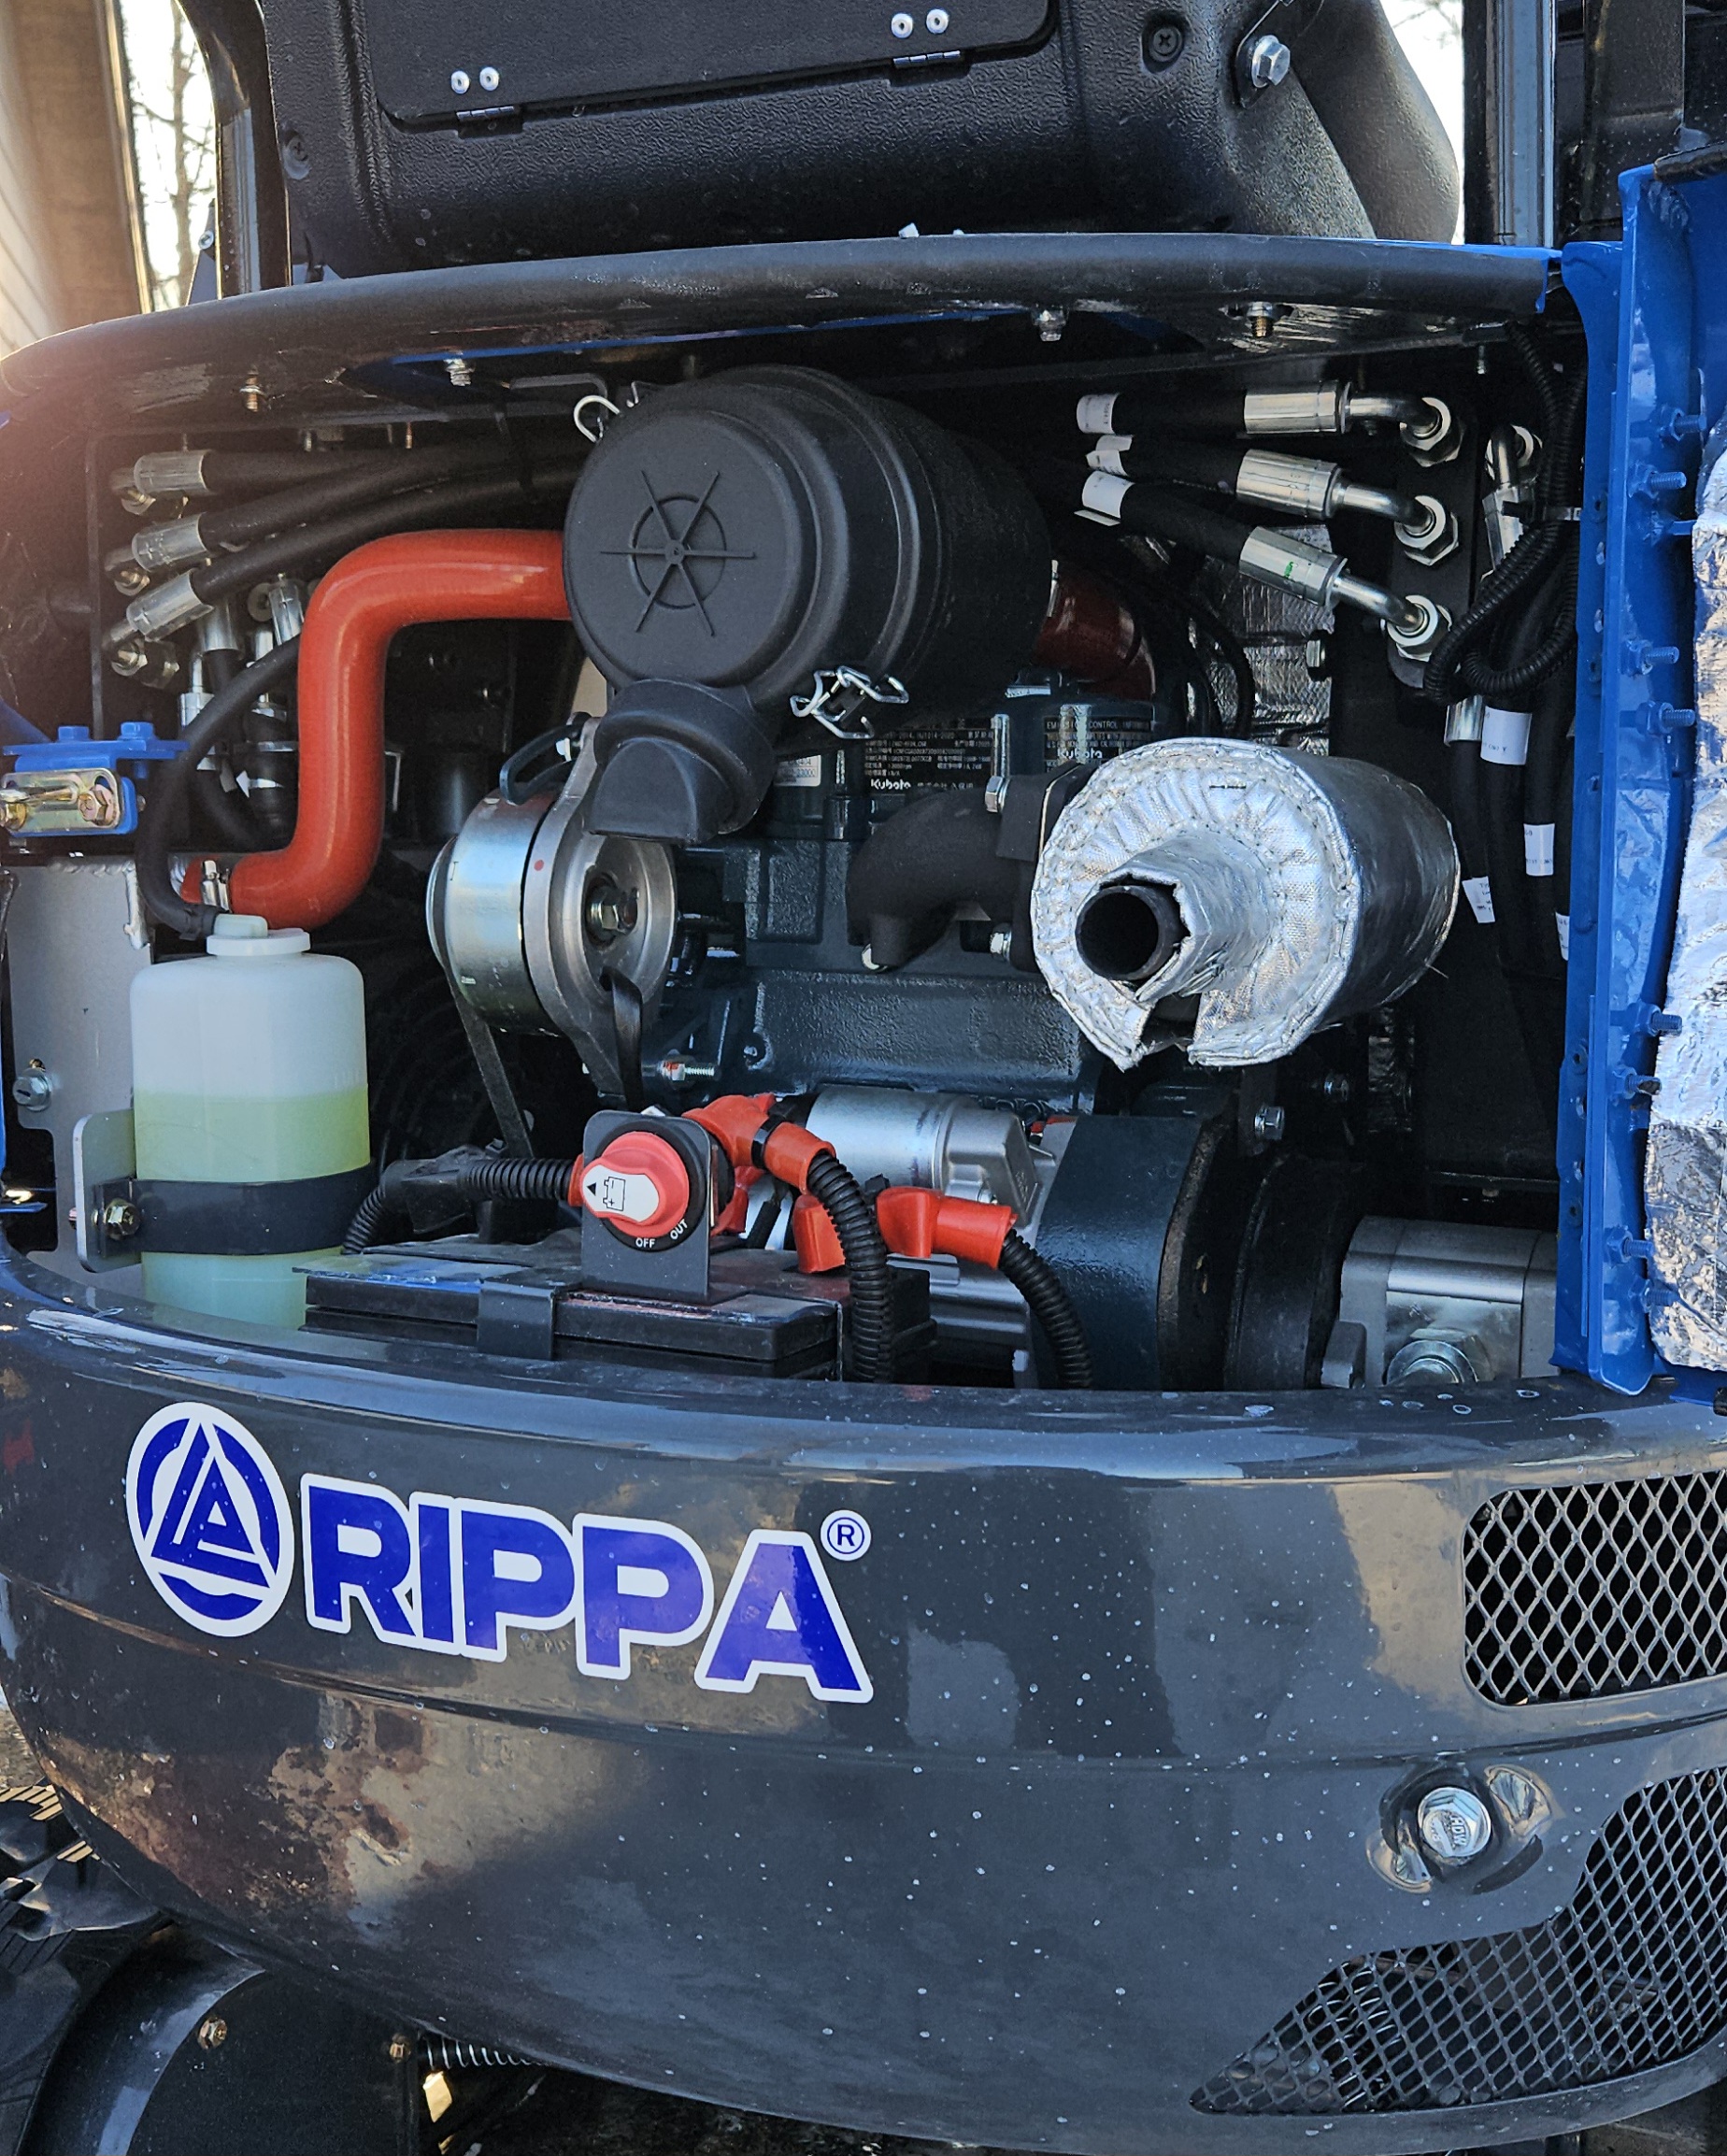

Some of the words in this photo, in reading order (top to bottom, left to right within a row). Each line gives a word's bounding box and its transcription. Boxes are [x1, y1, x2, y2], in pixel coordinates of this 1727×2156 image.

[1088, 721, 1119, 729] CONTROL
[870, 778, 912, 791] Kubota
[669, 1218, 688, 1240] OUT
[635, 1236, 656, 1249] OFF
[302, 1474, 874, 1704] RIPPA
